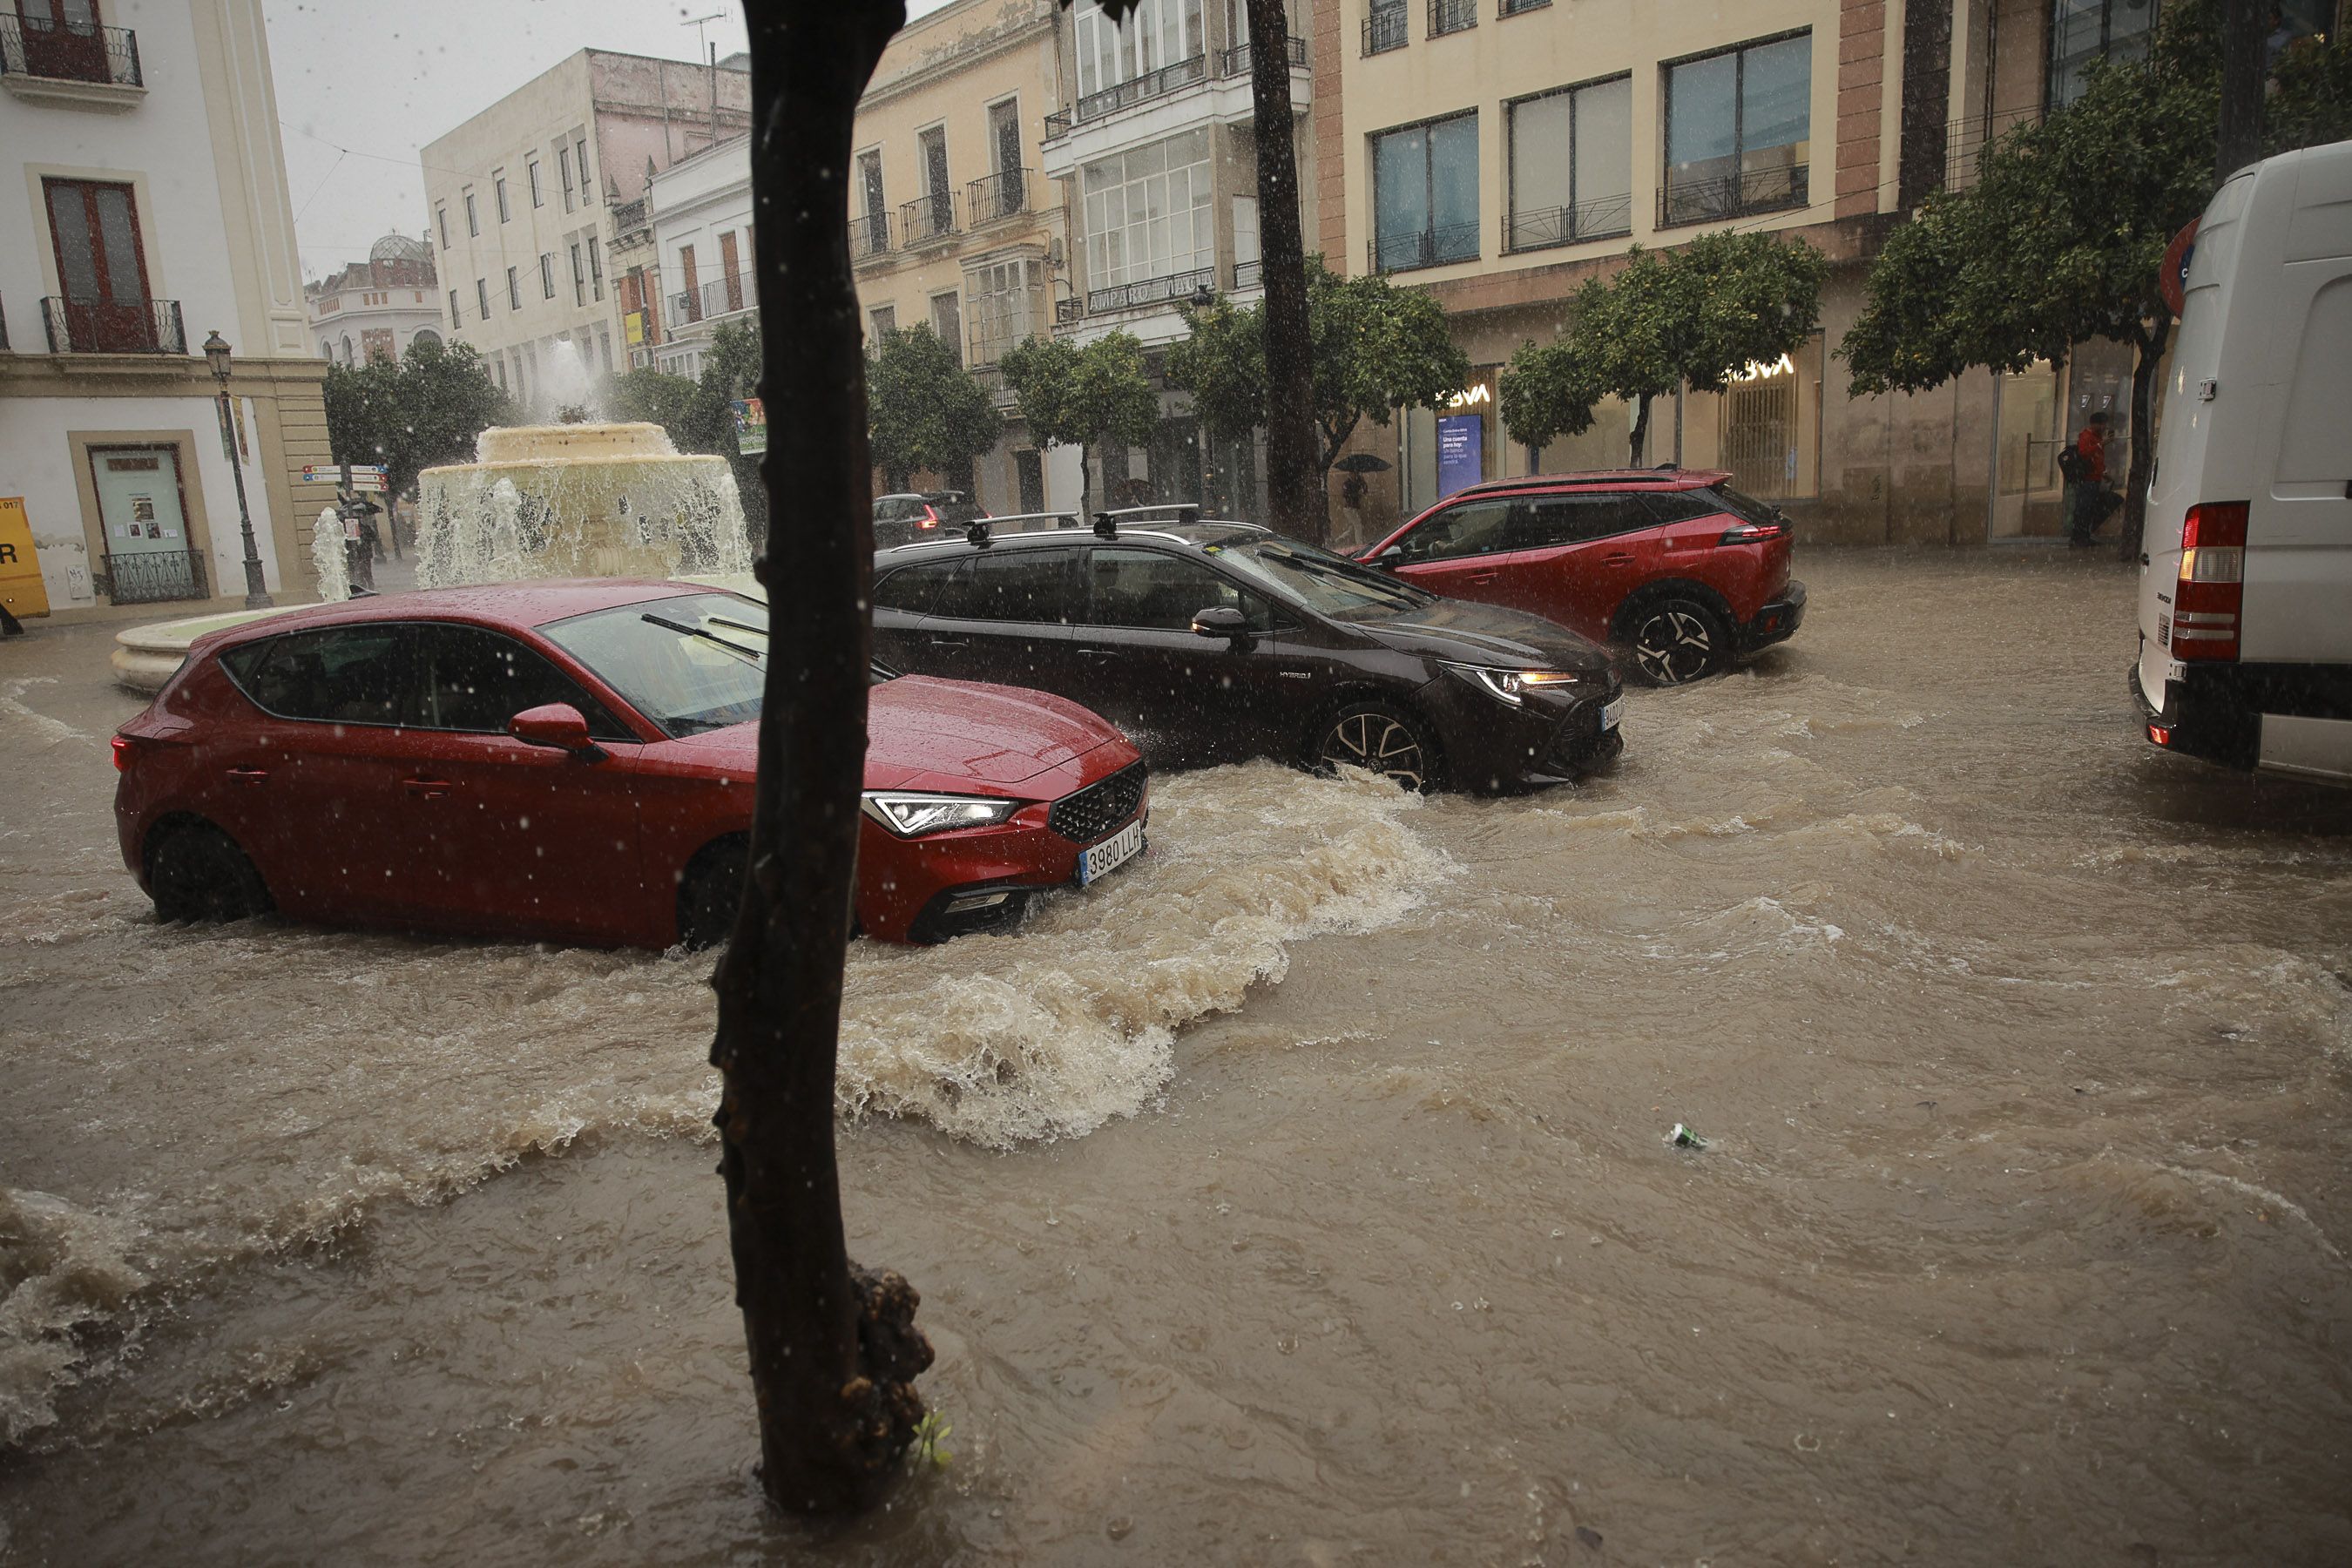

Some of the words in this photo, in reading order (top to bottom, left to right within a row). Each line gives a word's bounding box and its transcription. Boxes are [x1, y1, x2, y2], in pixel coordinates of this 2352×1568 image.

[1089, 285, 1149, 311] AMPARO
[1090, 841, 1119, 875] 3980
[1122, 825, 1140, 856] LLH
